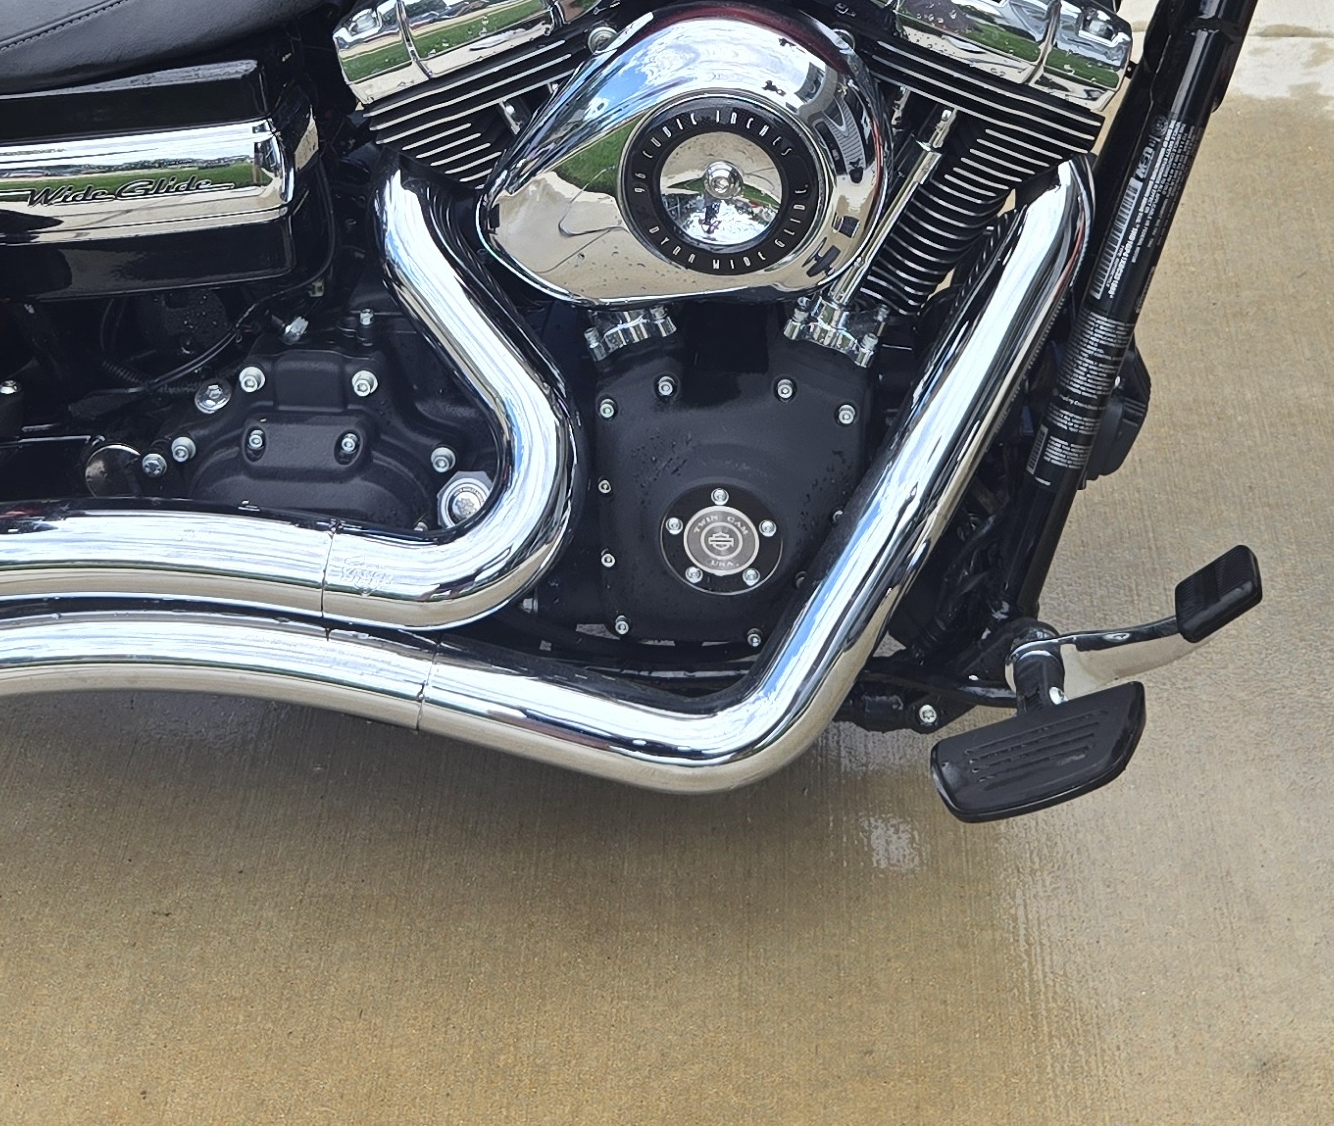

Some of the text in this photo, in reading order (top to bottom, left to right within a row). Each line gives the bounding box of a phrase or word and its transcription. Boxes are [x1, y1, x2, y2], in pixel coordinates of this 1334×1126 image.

[642, 112, 697, 159] CUBIC
[716, 110, 793, 156] INCHES
[115, 175, 235, 201] Glide
[693, 515, 749, 535] TWIN CAM
